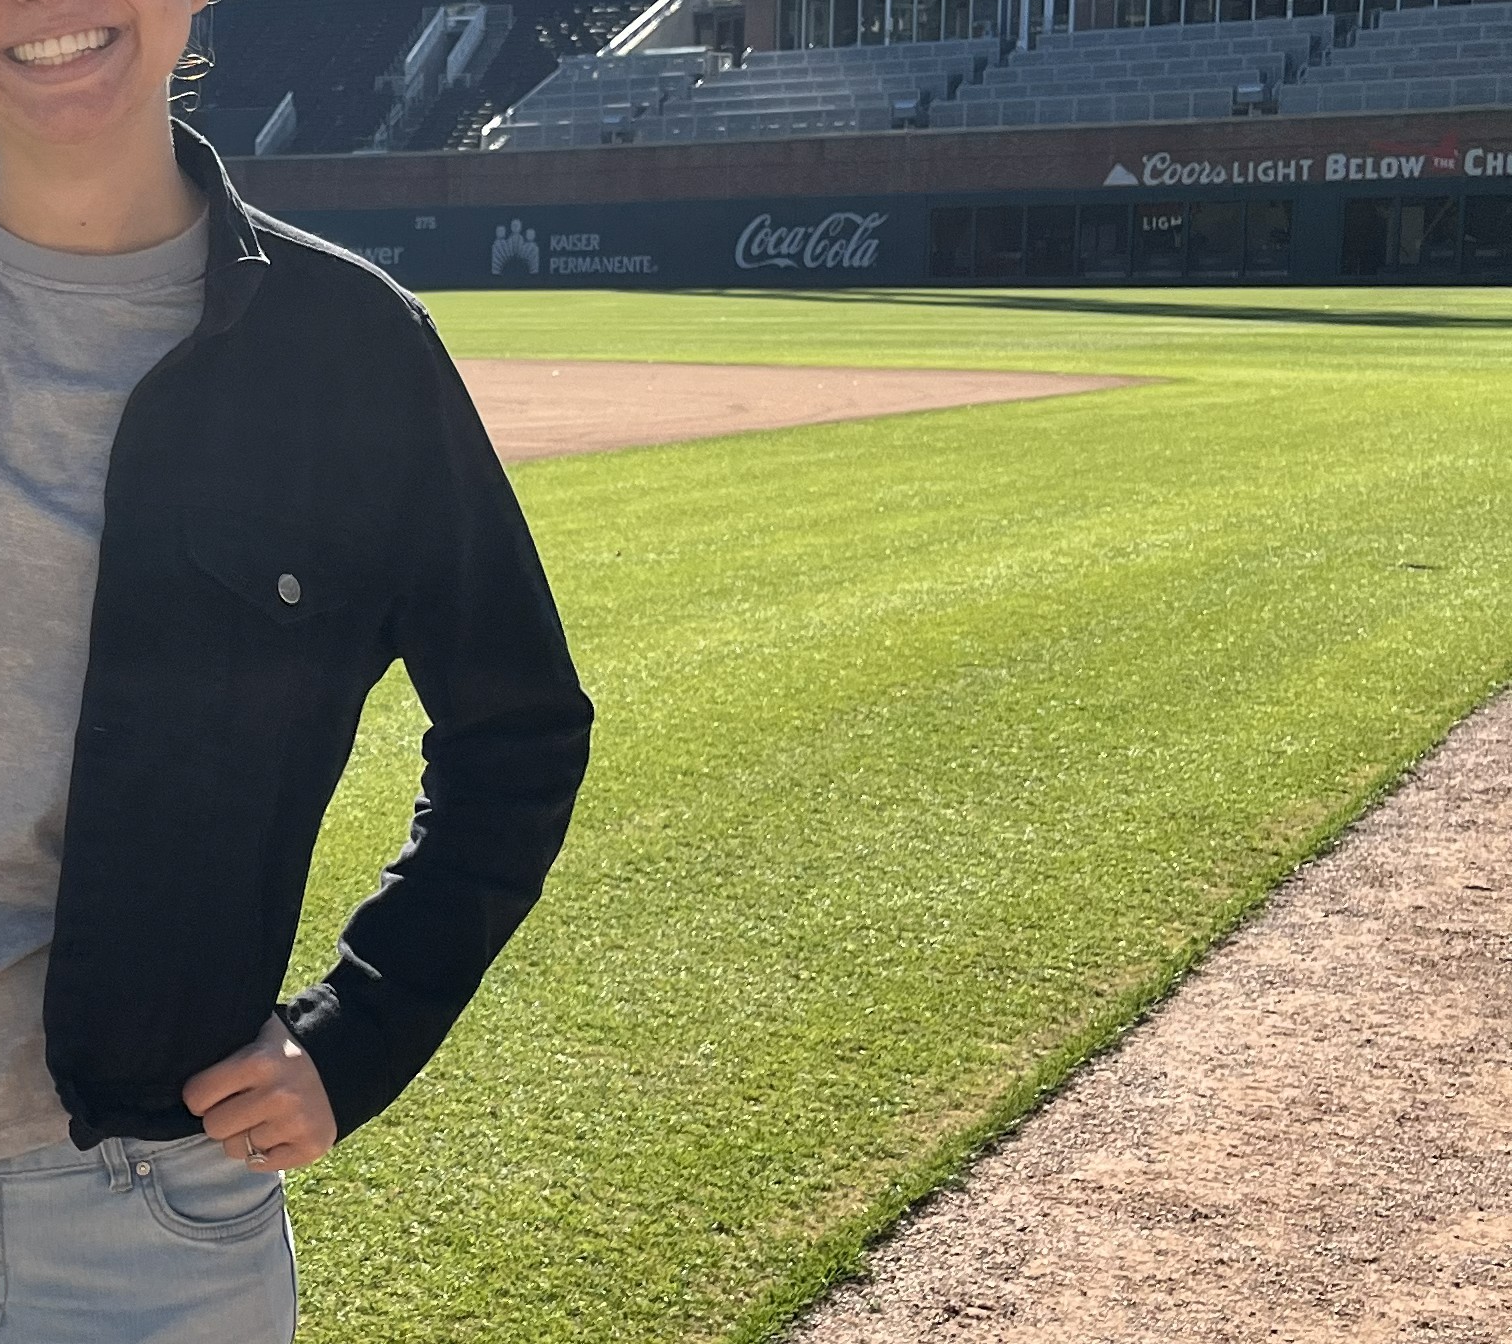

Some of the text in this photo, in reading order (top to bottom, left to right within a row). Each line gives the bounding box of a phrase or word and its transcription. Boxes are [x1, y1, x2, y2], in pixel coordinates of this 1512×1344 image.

[1141, 151, 1228, 186] Coors
[1232, 158, 1314, 185] LIGHT
[1463, 147, 1512, 177] CH
[549, 232, 601, 253] KAISER
[735, 211, 888, 270] Coca-Cola
[549, 253, 653, 275] PERMANENTE
